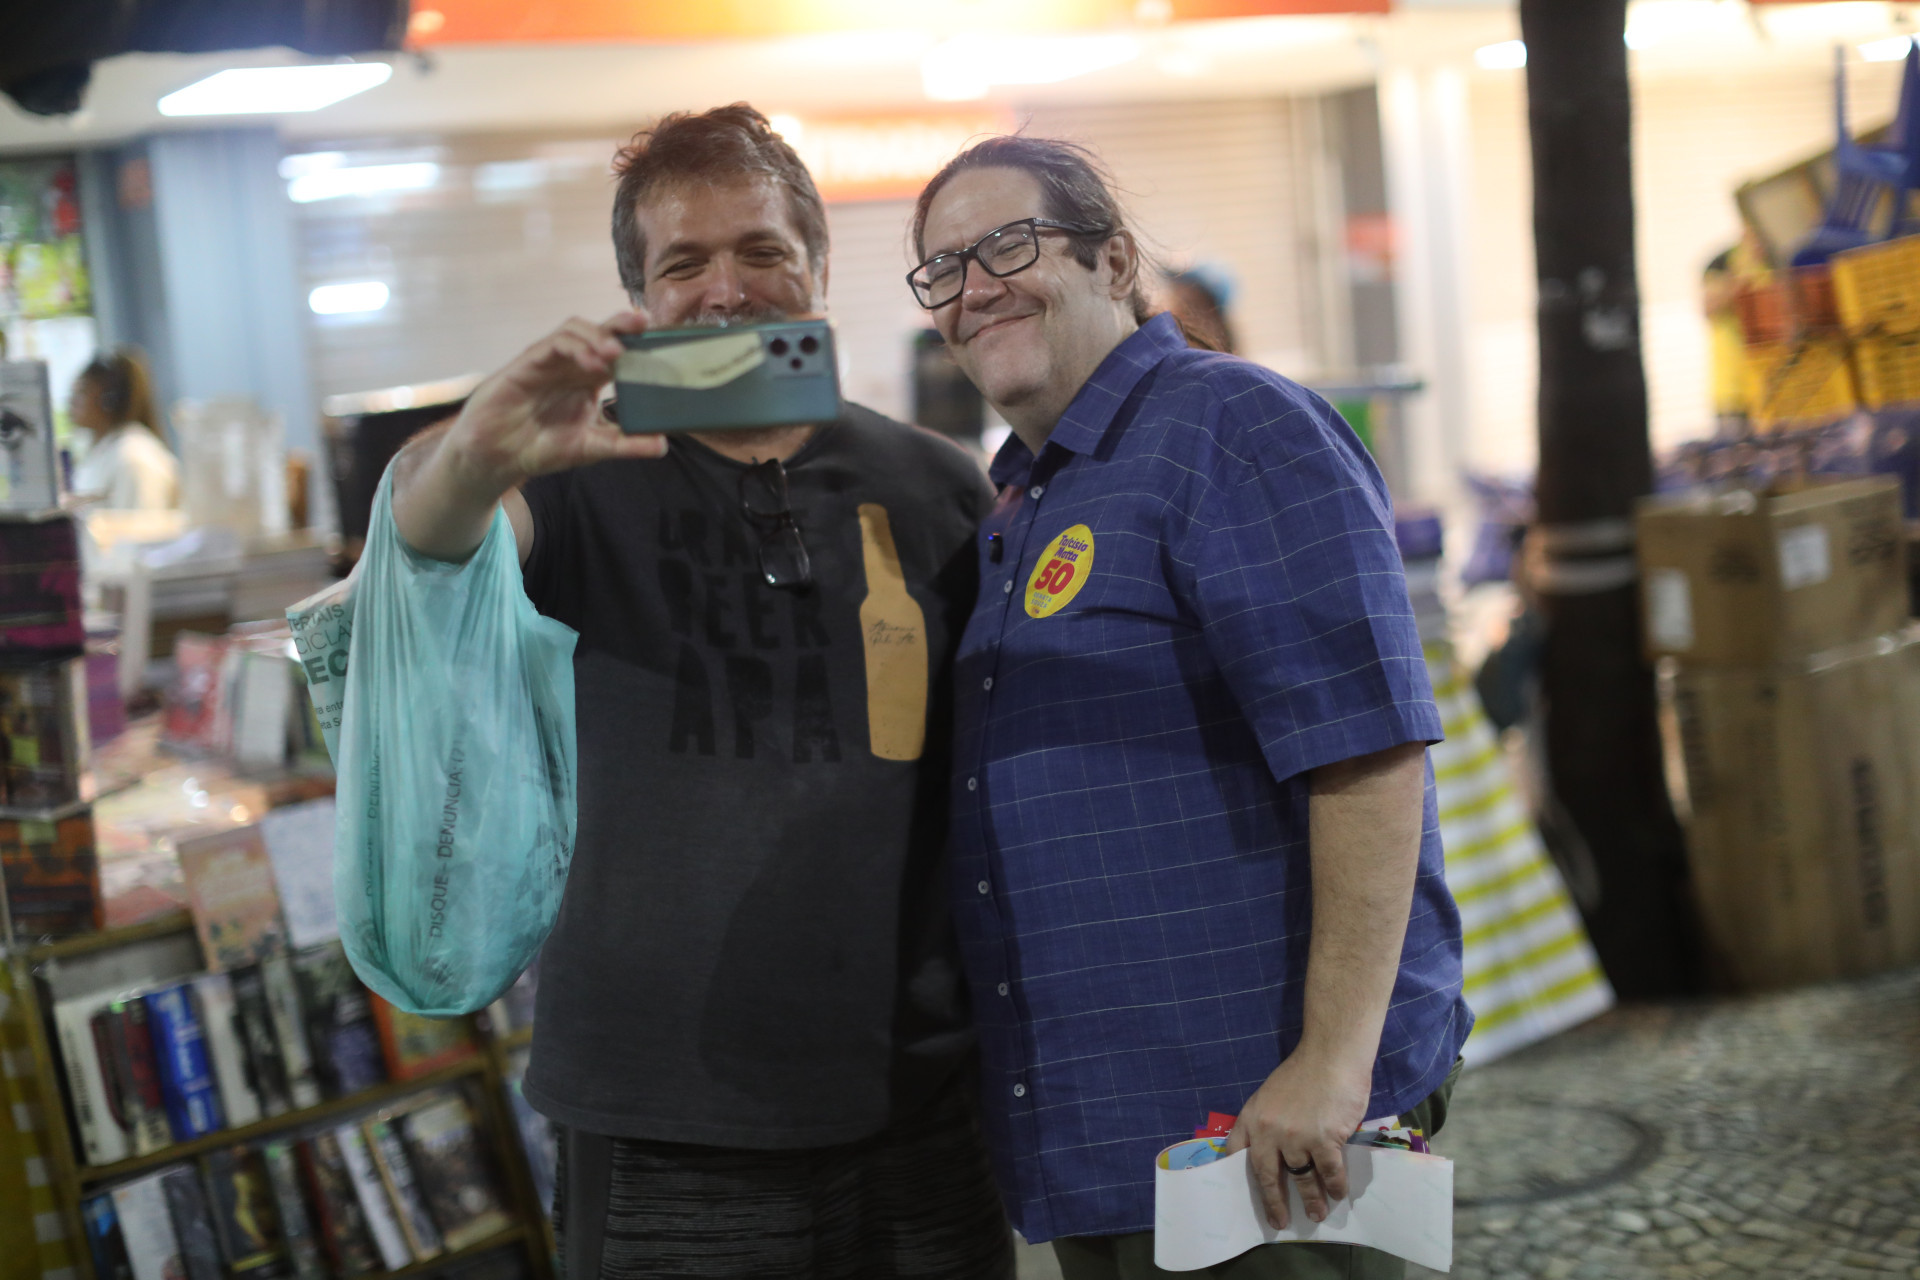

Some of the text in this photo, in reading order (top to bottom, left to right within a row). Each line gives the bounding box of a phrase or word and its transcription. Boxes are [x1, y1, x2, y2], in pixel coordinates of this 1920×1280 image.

[1054, 547, 1078, 562] Motta
[1034, 559, 1075, 595] 50
[294, 619, 353, 654] CICLÁ
[669, 642, 842, 764] APA
[429, 875, 449, 938] DISQUE
